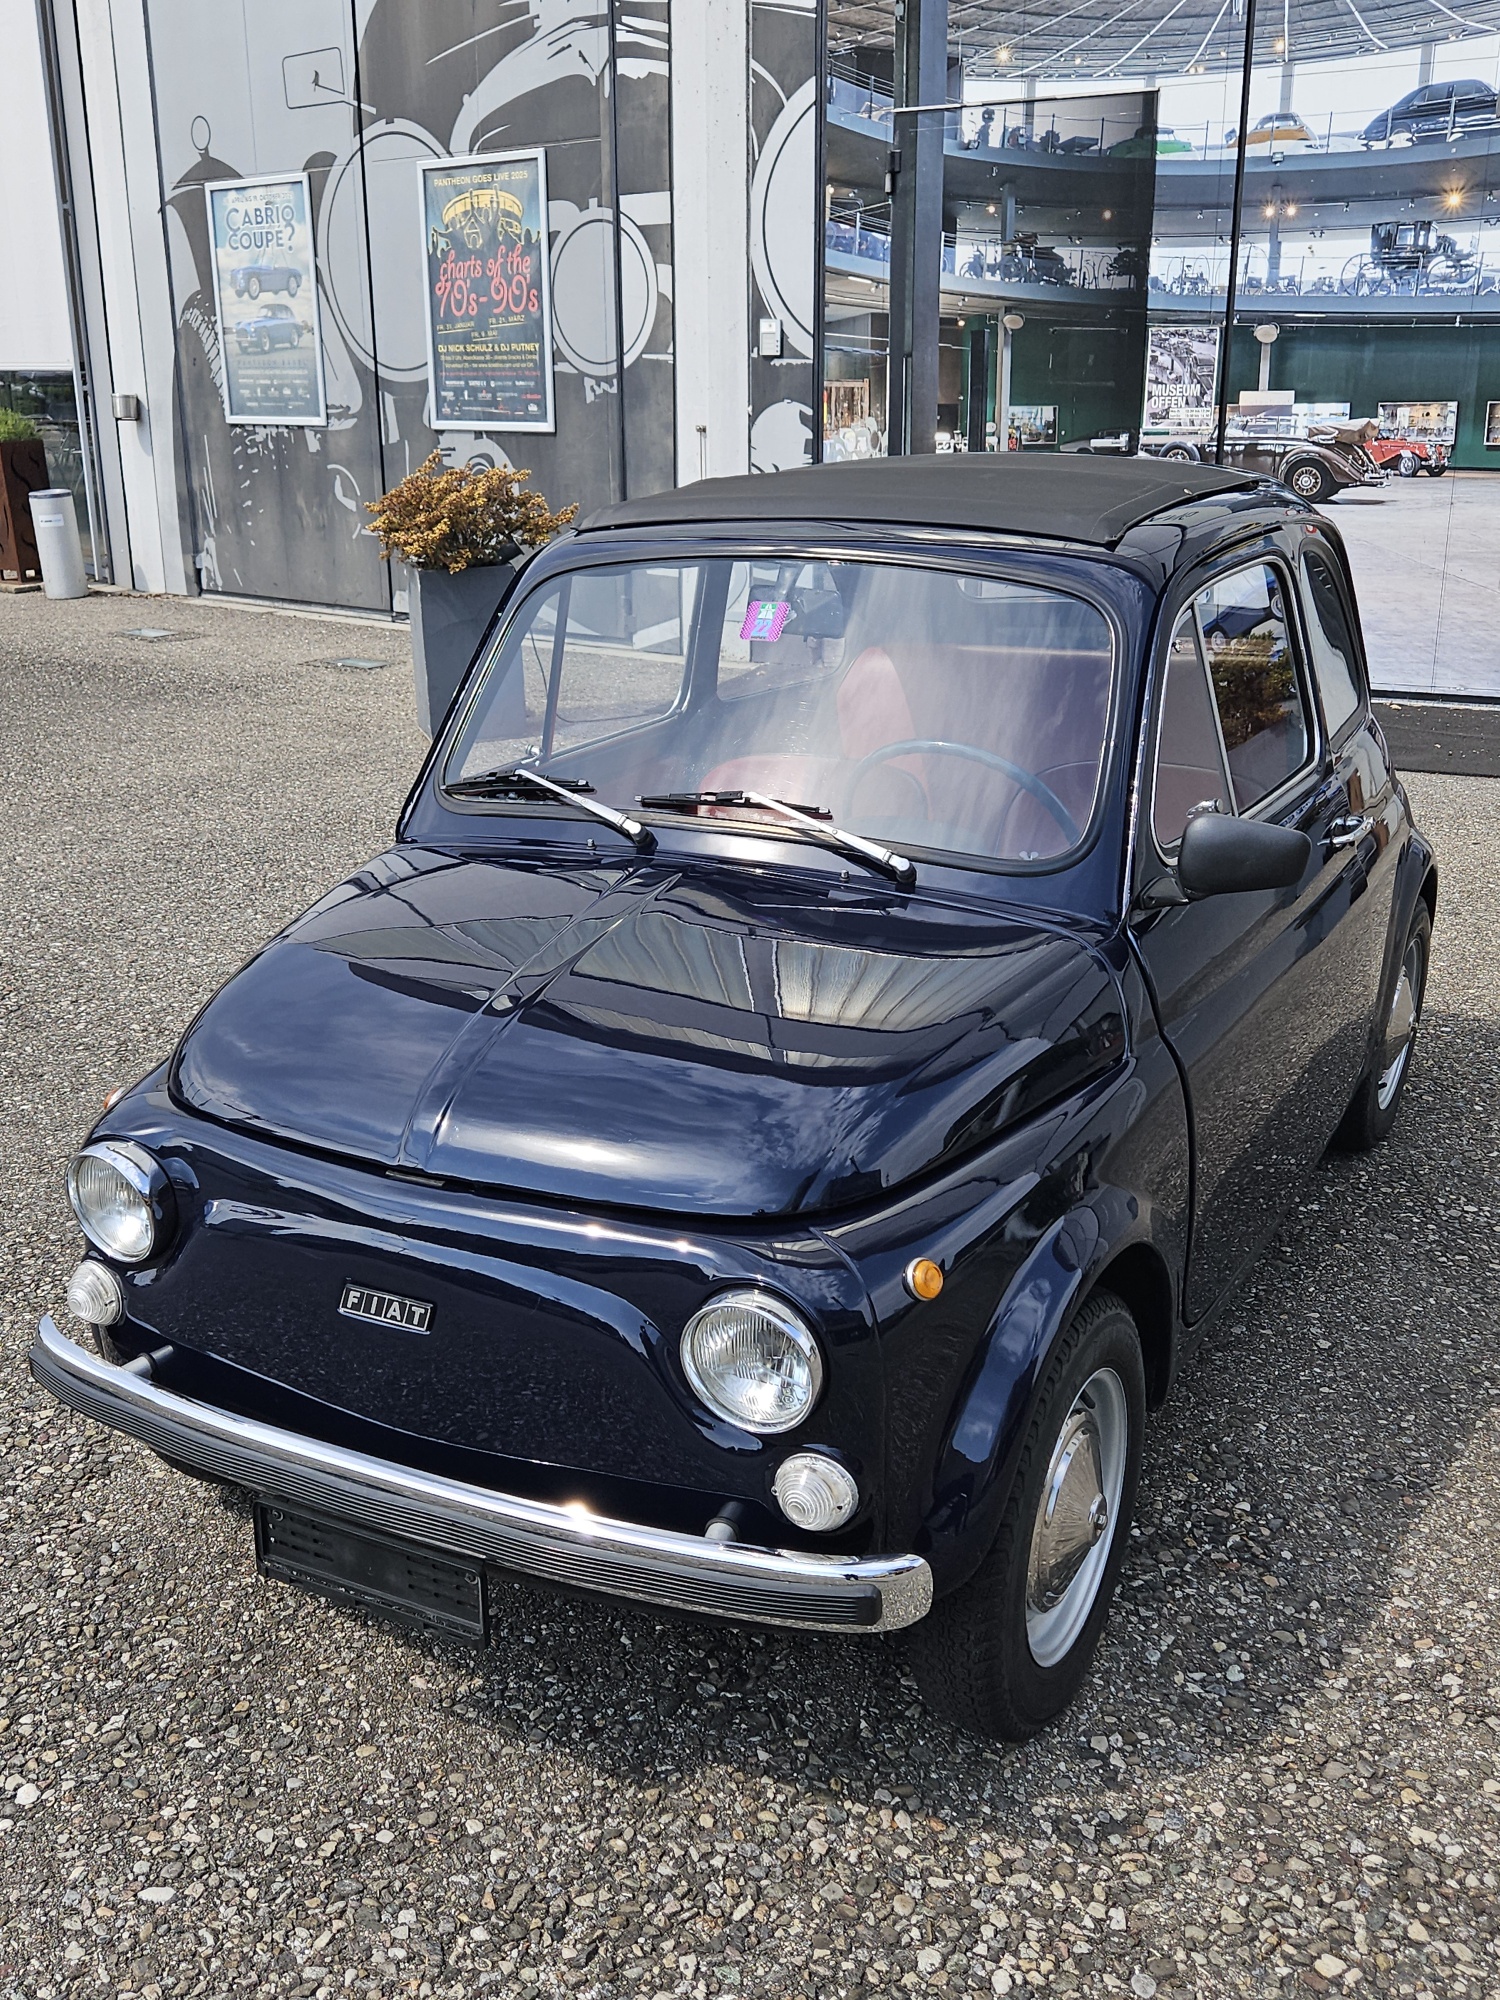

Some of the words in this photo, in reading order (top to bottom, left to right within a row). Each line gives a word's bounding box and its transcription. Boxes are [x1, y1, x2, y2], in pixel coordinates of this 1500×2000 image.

[434, 177, 471, 187] PANTHEON
[472, 174, 492, 183] GOES
[493, 172, 509, 181] LIVE
[511, 170, 528, 180] 2025
[226, 204, 295, 232] CABRIO
[440, 249, 482, 281] charts
[486, 244, 506, 284] of
[507, 243, 531, 274] the
[438, 344, 447, 352] DJ
[449, 344, 465, 352] NICK
[466, 343, 493, 352] SCHULZ
[494, 344, 499, 352] &
[500, 343, 510, 352] DJ
[511, 343, 540, 352] PUTNEY
[1152, 384, 1201, 396] MUSEUM
[1152, 396, 1187, 408] OFFEN
[751, 619, 772, 637] 22
[346, 1290, 425, 1325] FIAT
